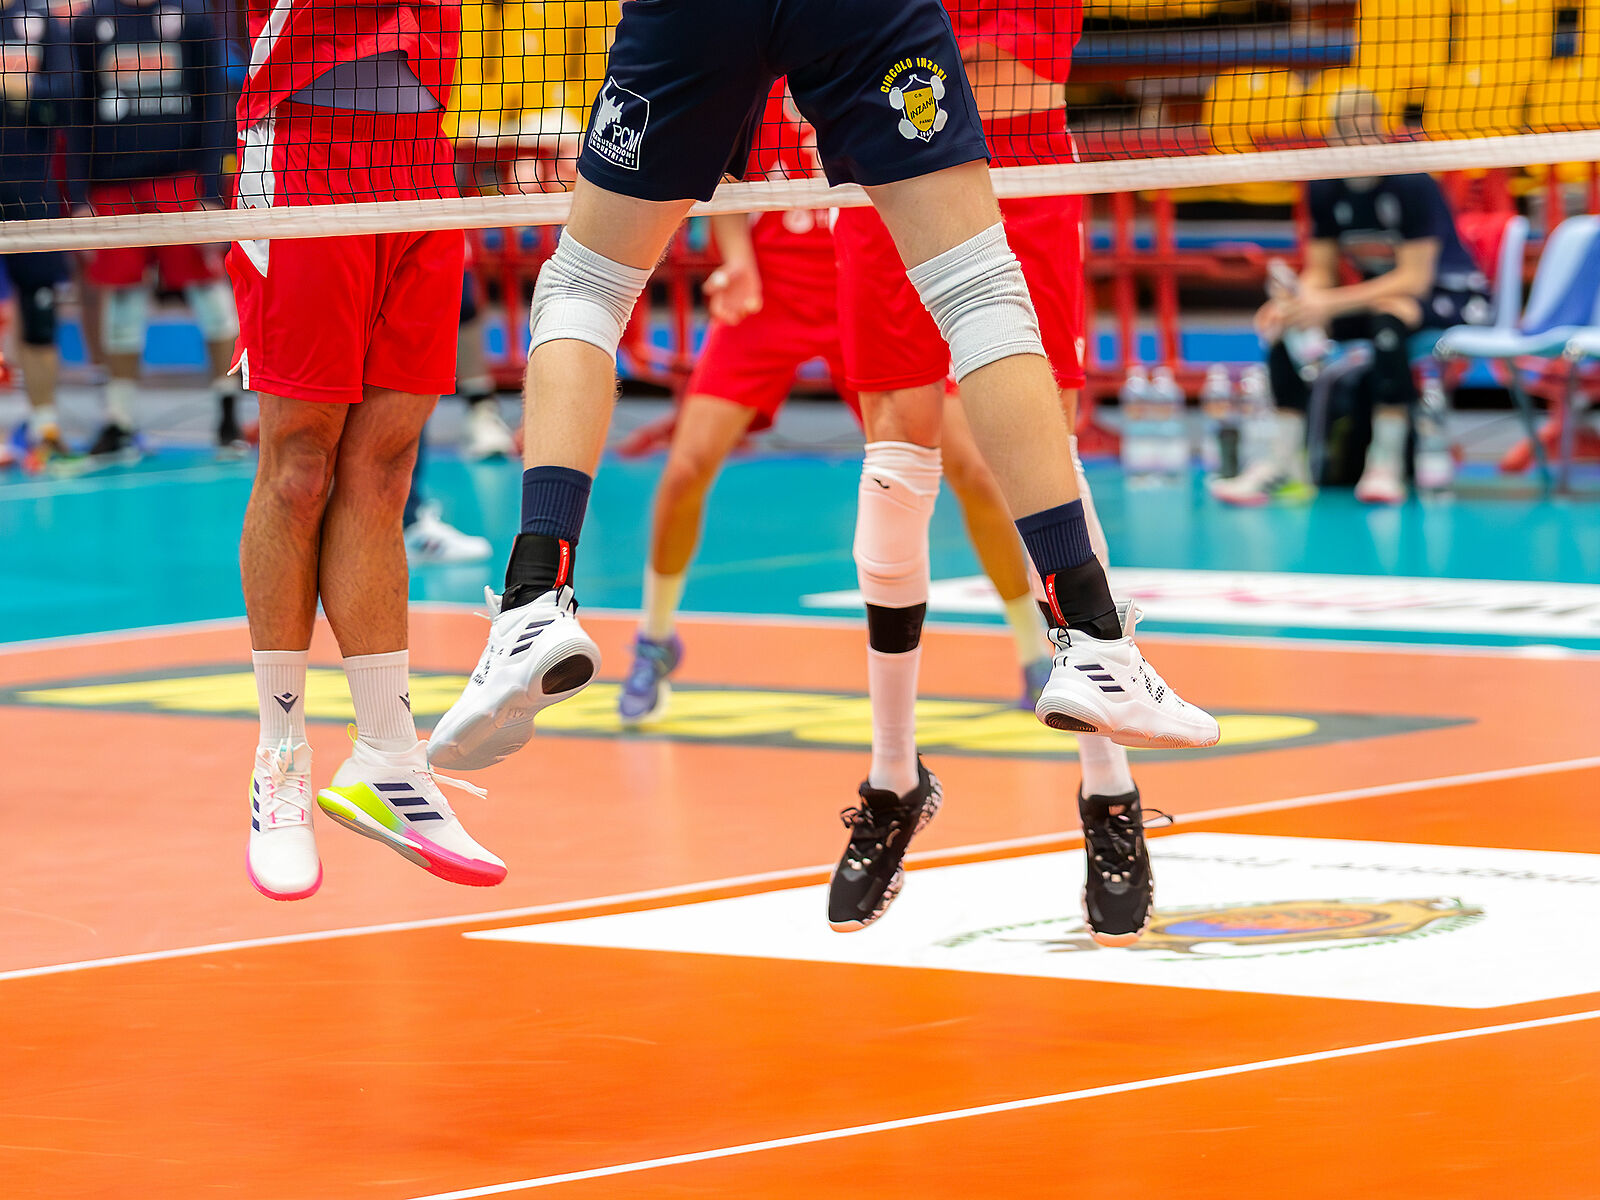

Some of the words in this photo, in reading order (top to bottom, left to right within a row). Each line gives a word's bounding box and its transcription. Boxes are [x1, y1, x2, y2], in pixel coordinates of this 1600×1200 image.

[880, 57, 914, 94] CIRCOLO
[916, 57, 948, 81] INZANI
[910, 96, 934, 120] INZANI
[613, 124, 640, 152] PCM
